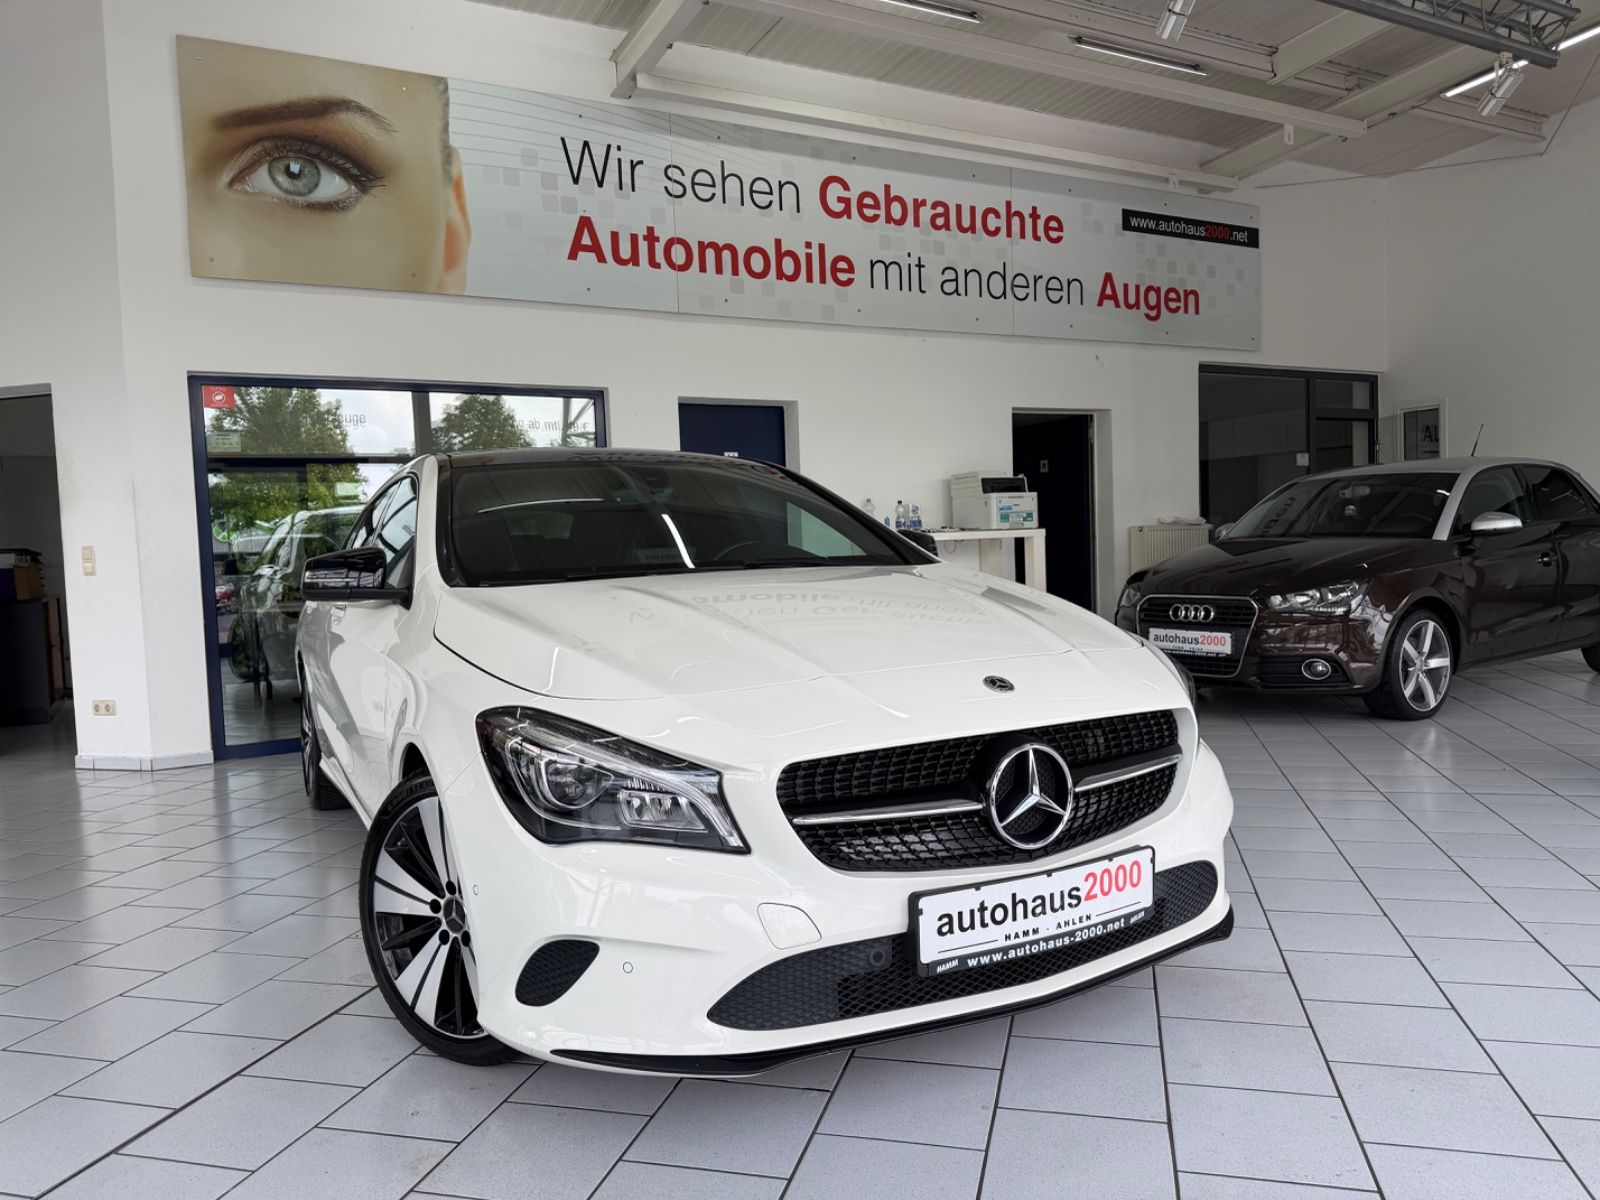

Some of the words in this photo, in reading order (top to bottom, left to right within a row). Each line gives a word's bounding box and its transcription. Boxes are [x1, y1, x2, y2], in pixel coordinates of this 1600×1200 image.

[560, 136, 644, 192] Wir
[663, 159, 801, 213] sehen
[818, 174, 1065, 245] Gebrauchte
[1129, 216, 1249, 243] www.autohaus2000.net
[567, 215, 856, 287] Automobile
[869, 252, 926, 294] mit
[939, 262, 1084, 306] anderen
[1096, 272, 1201, 322] Augen
[1153, 632, 1227, 647] autohaus2000
[936, 859, 1142, 938] autohaus2000
[966, 917, 1126, 968] www.autohaus-2000.net
[1004, 927, 1040, 942] HAMM
[1056, 913, 1093, 930] AHLEN
